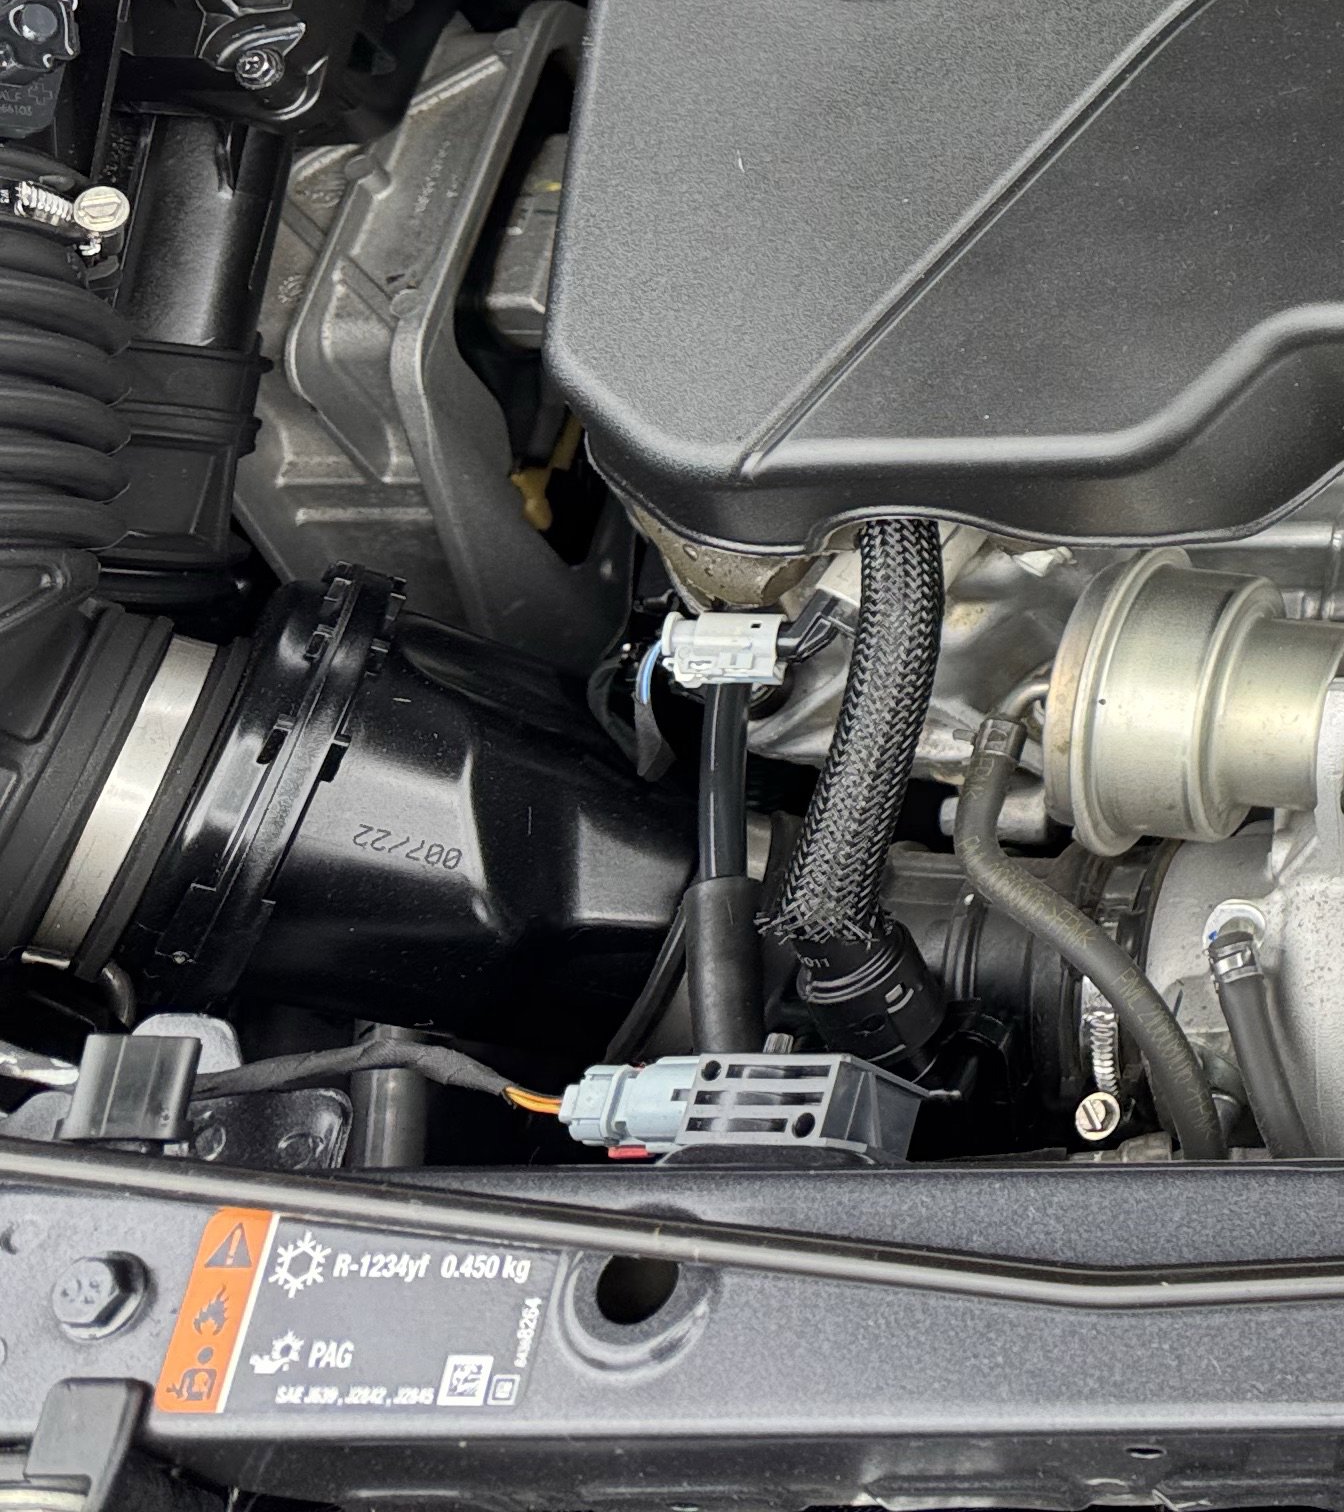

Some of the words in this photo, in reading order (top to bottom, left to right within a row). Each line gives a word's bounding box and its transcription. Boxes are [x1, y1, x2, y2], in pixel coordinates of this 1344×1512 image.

[353, 823, 462, 869] 007/22
[333, 1253, 431, 1282] R-1234yf
[440, 1255, 500, 1279] 0.450
[502, 1258, 532, 1284] kg
[308, 1341, 355, 1368] PAG
[275, 1384, 305, 1405] SAE
